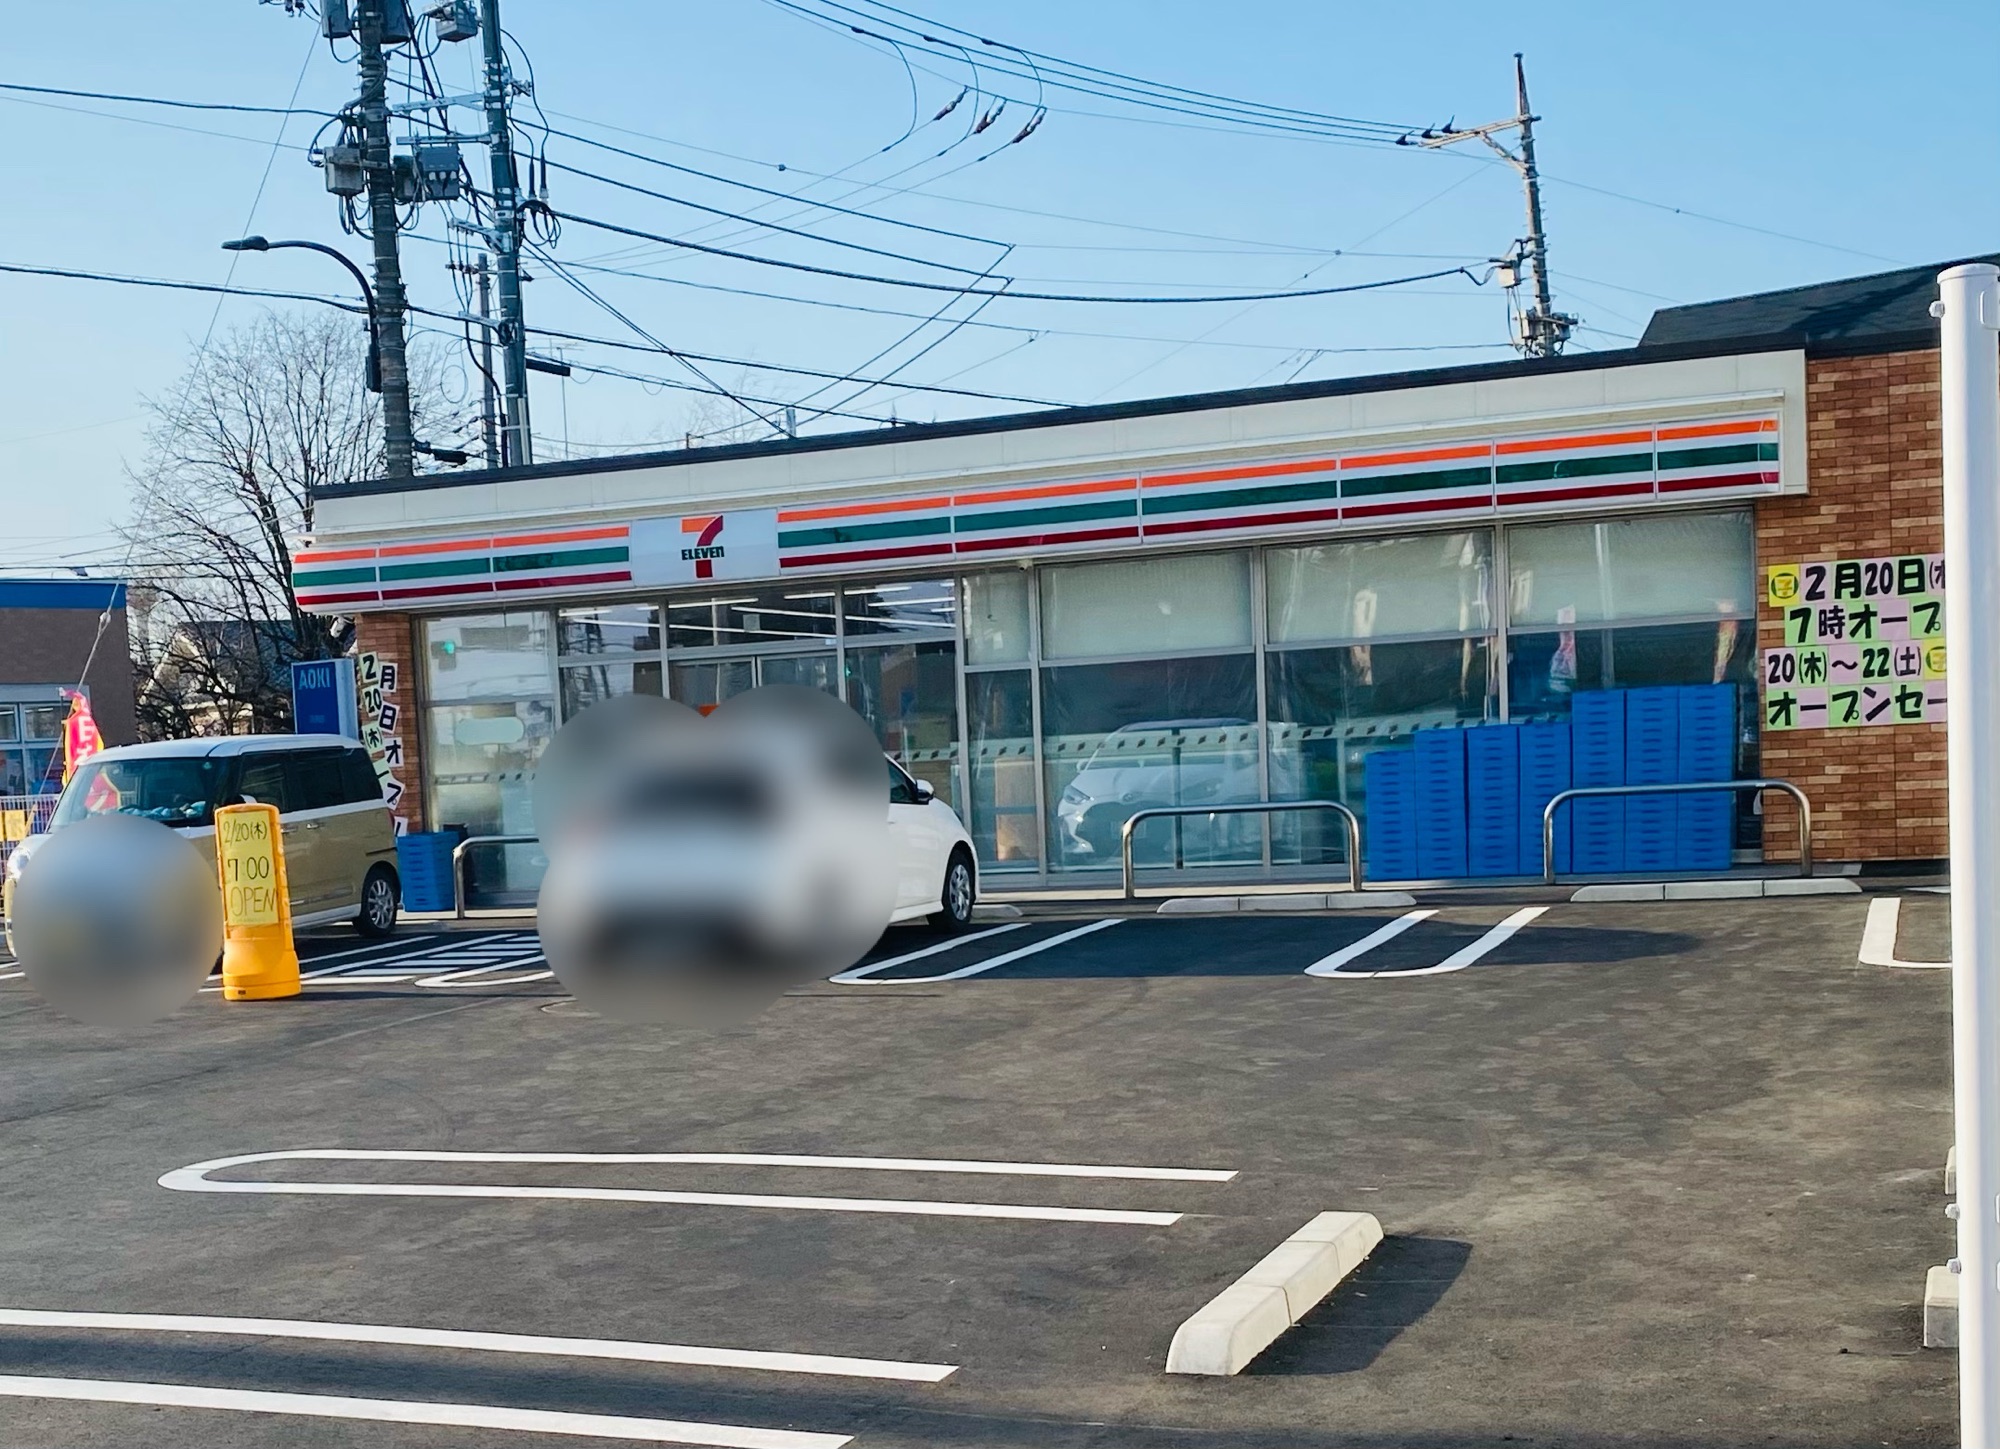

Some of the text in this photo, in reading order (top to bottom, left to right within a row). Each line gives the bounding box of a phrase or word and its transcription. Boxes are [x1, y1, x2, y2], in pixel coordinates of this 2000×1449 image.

[1789, 602, 1941, 643] 7時オープ
[299, 667, 331, 690] AOKI
[1768, 685, 1947, 726] オープンセー
[223, 820, 267, 845] 2/20(木)
[227, 856, 269, 882] 7:00
[230, 886, 275, 916] OPEN
